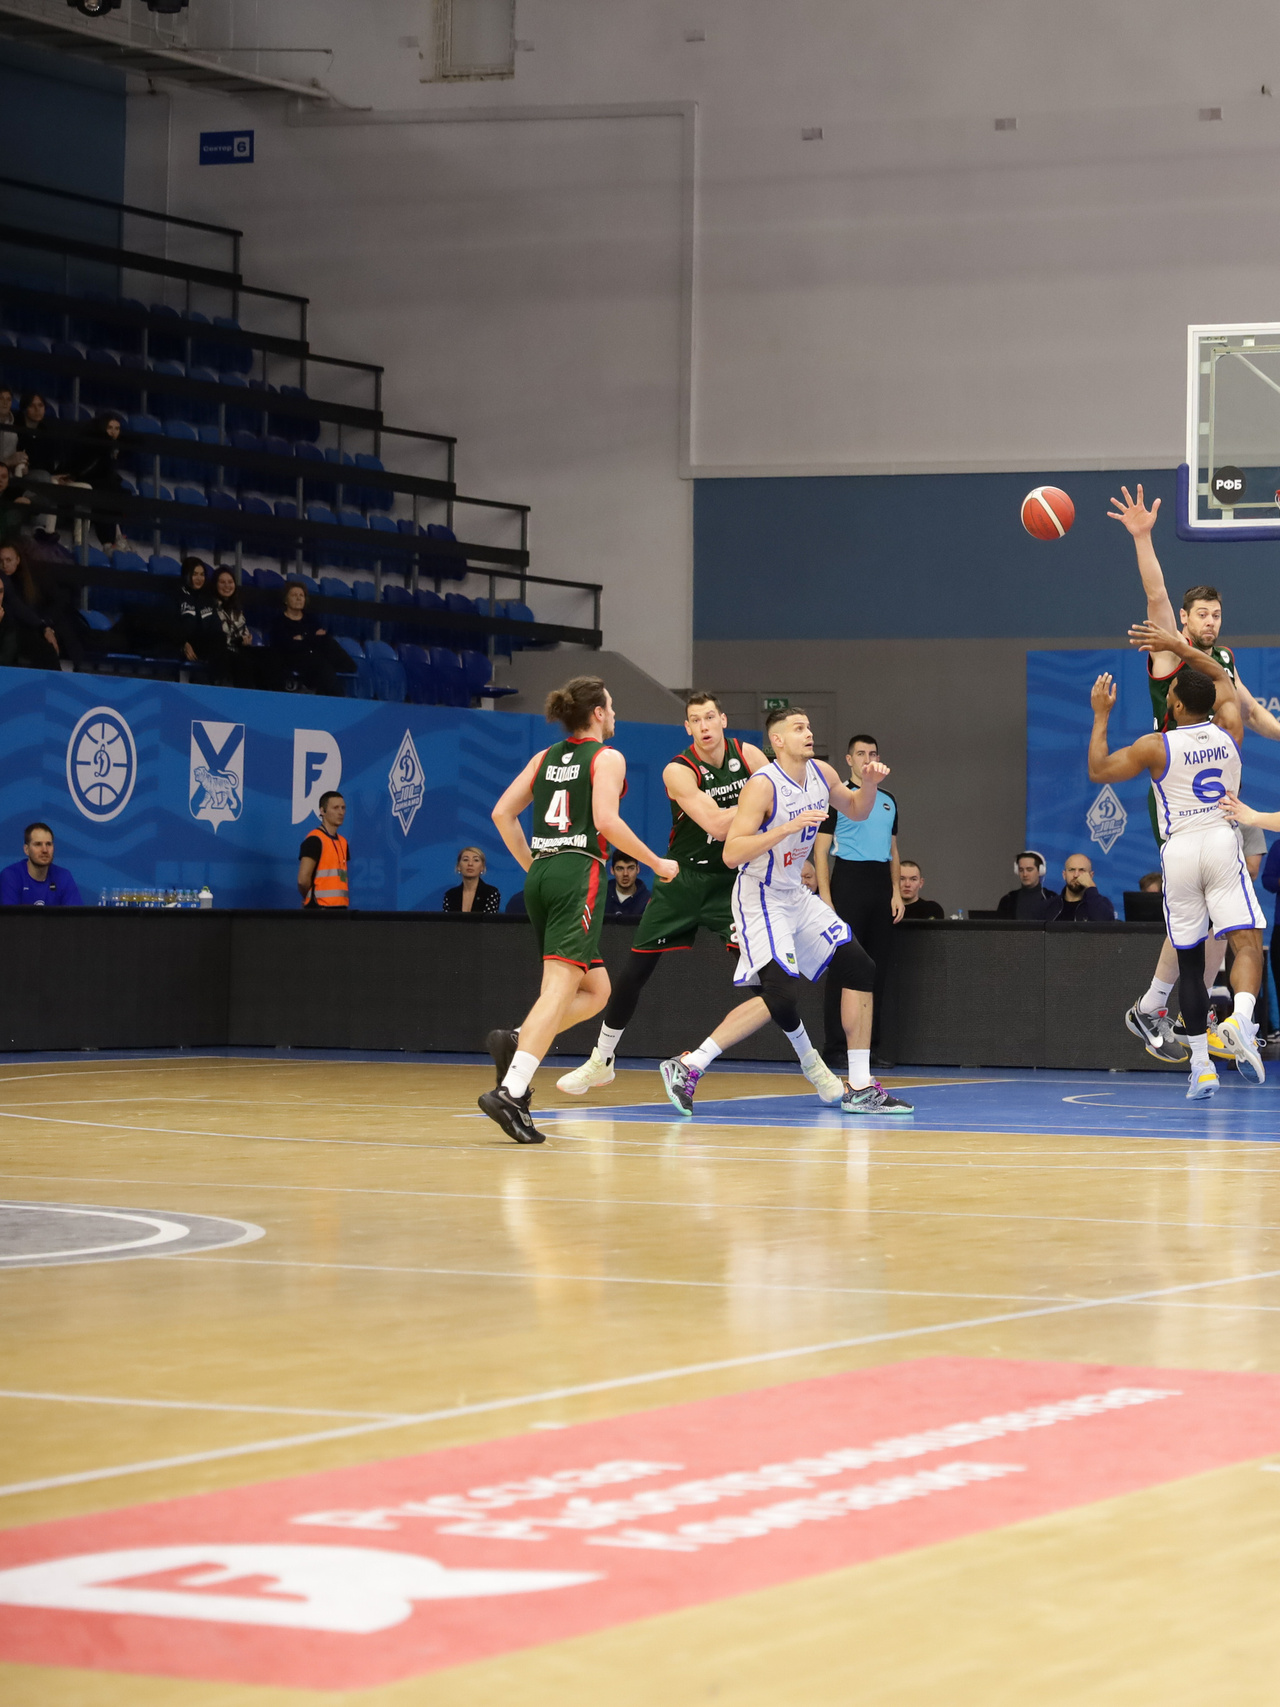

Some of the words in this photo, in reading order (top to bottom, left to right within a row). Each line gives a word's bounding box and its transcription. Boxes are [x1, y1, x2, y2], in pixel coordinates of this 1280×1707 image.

[237, 141, 247, 153] 6
[1216, 479, 1242, 491] РФБ
[1184, 746, 1229, 765] ХАРРИС
[1192, 768, 1226, 804] 6
[544, 789, 572, 832] 4
[820, 921, 844, 945] 15
